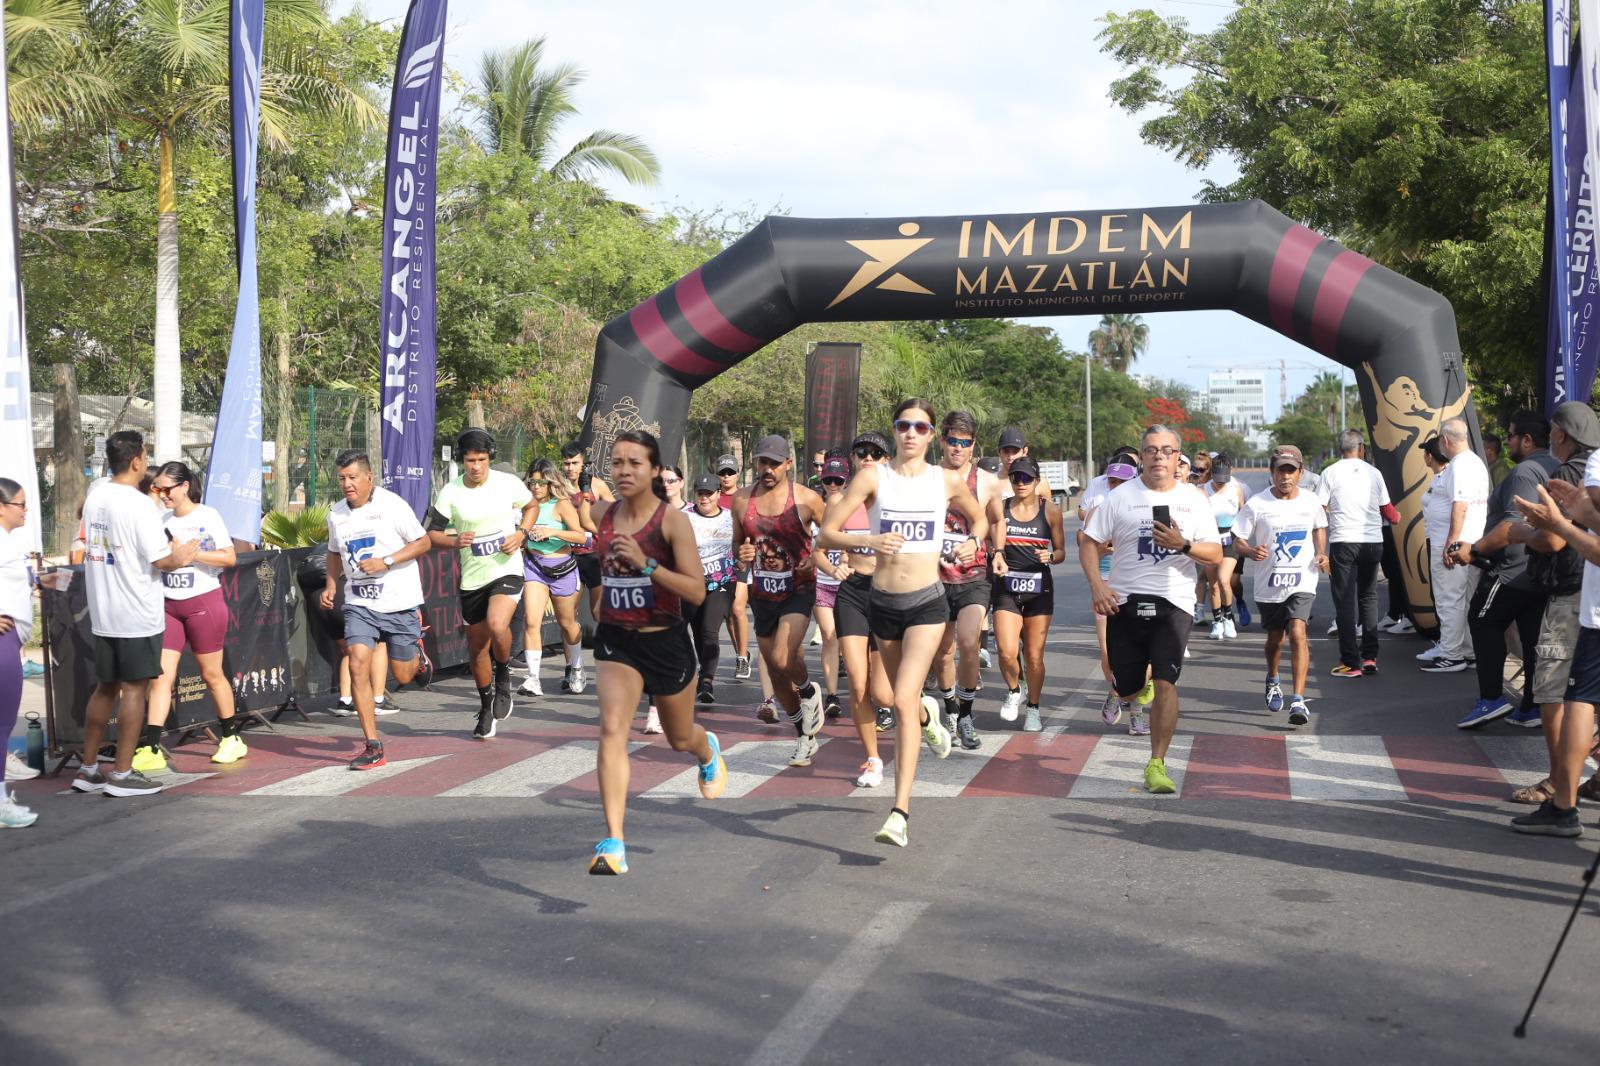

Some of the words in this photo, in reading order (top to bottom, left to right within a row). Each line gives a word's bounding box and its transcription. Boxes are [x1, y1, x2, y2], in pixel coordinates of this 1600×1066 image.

[413, 117, 429, 289] RESIDENCIAL
[958, 211, 1192, 258] IMDEM
[383, 101, 419, 435] ARCANGEL
[956, 251, 1189, 295] MAZATLÁN
[955, 299, 1023, 308] INSTITUTO
[1028, 295, 1096, 305] MUNICIPAL
[1102, 294, 1125, 303] DEL
[1129, 291, 1185, 302] DEPORTE
[408, 305, 420, 421] DISTRITO
[891, 521, 927, 541] 006
[1006, 525, 1038, 535] TRIMAZ
[478, 540, 501, 556] 101
[167, 573, 190, 588] 005
[763, 577, 787, 593] 034
[1011, 578, 1036, 592] 089
[1273, 573, 1296, 588] 040
[359, 584, 380, 600] 058
[610, 588, 645, 609] 016
